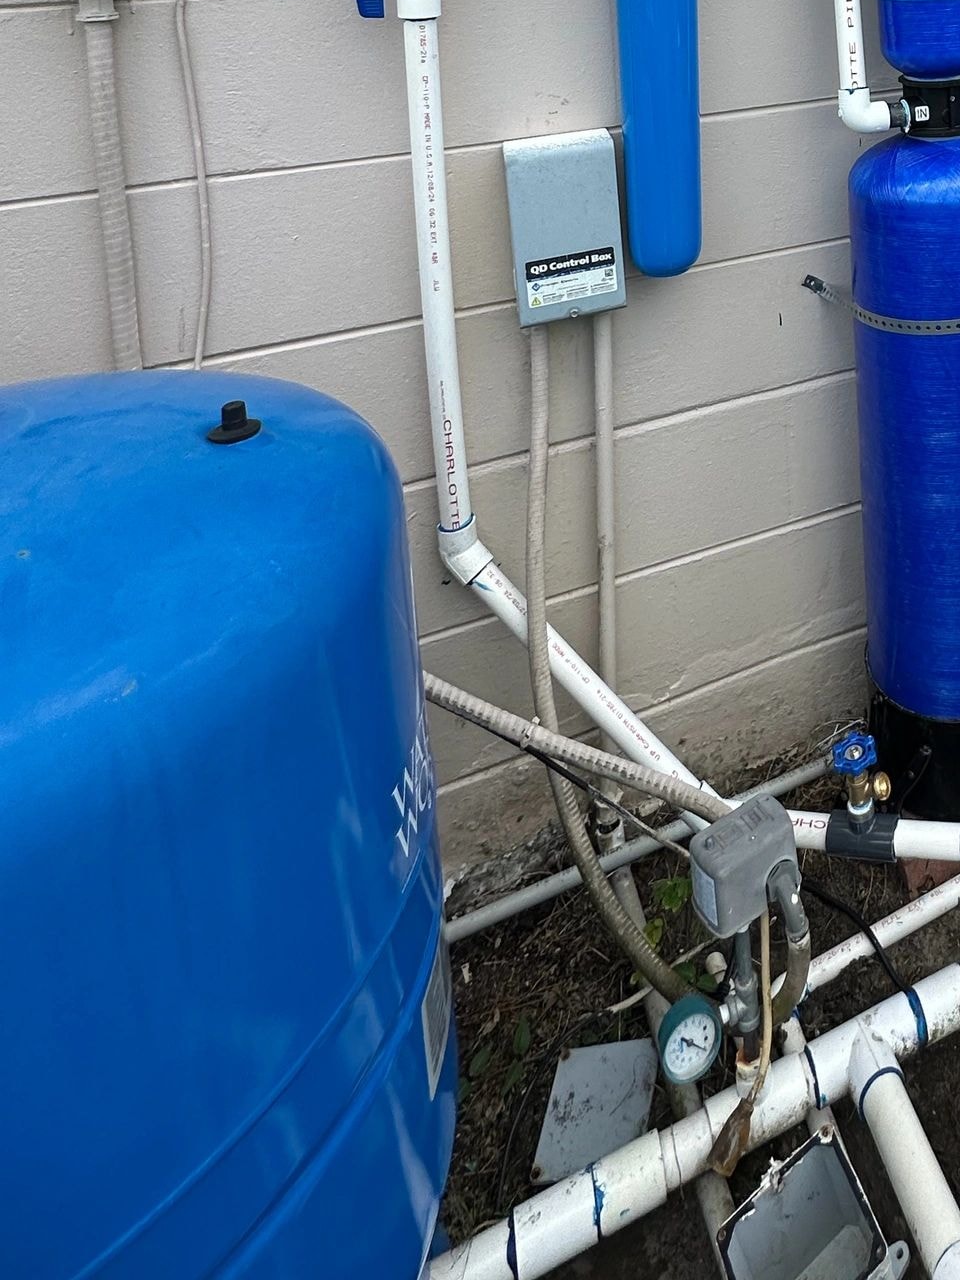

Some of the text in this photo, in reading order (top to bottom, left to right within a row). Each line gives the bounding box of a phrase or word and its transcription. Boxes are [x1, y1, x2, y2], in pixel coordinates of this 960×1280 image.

[422, 112, 431, 130] MADE
[917, 109, 928, 119] IN
[423, 133, 432, 143] IN
[530, 252, 612, 275] QD Control Box
[442, 418, 460, 530] CHARLOTTE
